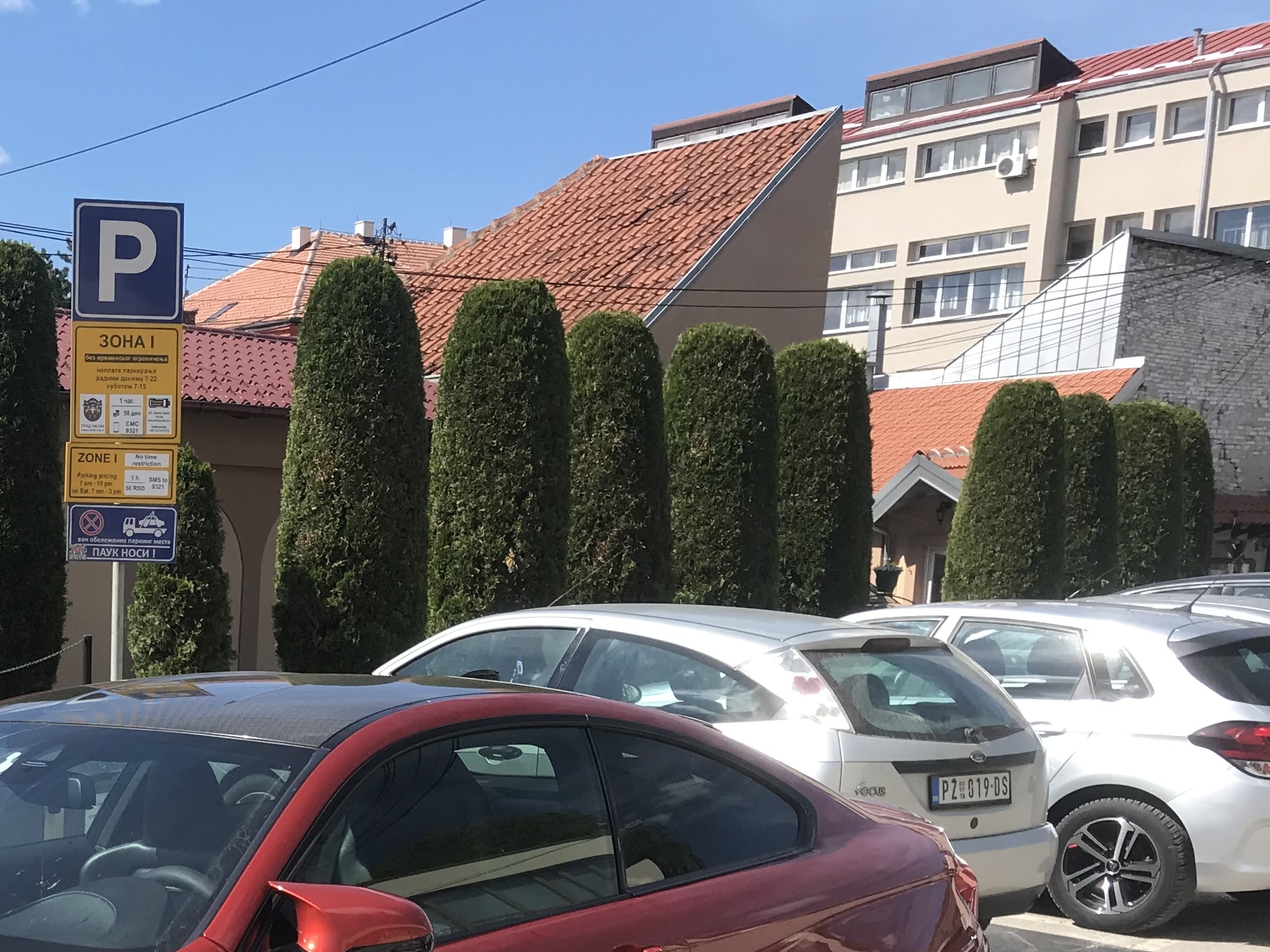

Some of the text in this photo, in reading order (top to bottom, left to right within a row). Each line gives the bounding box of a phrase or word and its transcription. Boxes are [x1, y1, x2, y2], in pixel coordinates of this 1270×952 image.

[98, 219, 157, 303] P
[99, 334, 146, 349] ЗОНА
[77, 452, 111, 463] ZONE
[92, 547, 120, 557] ПАУК
[121, 548, 150, 558] НОСИ
